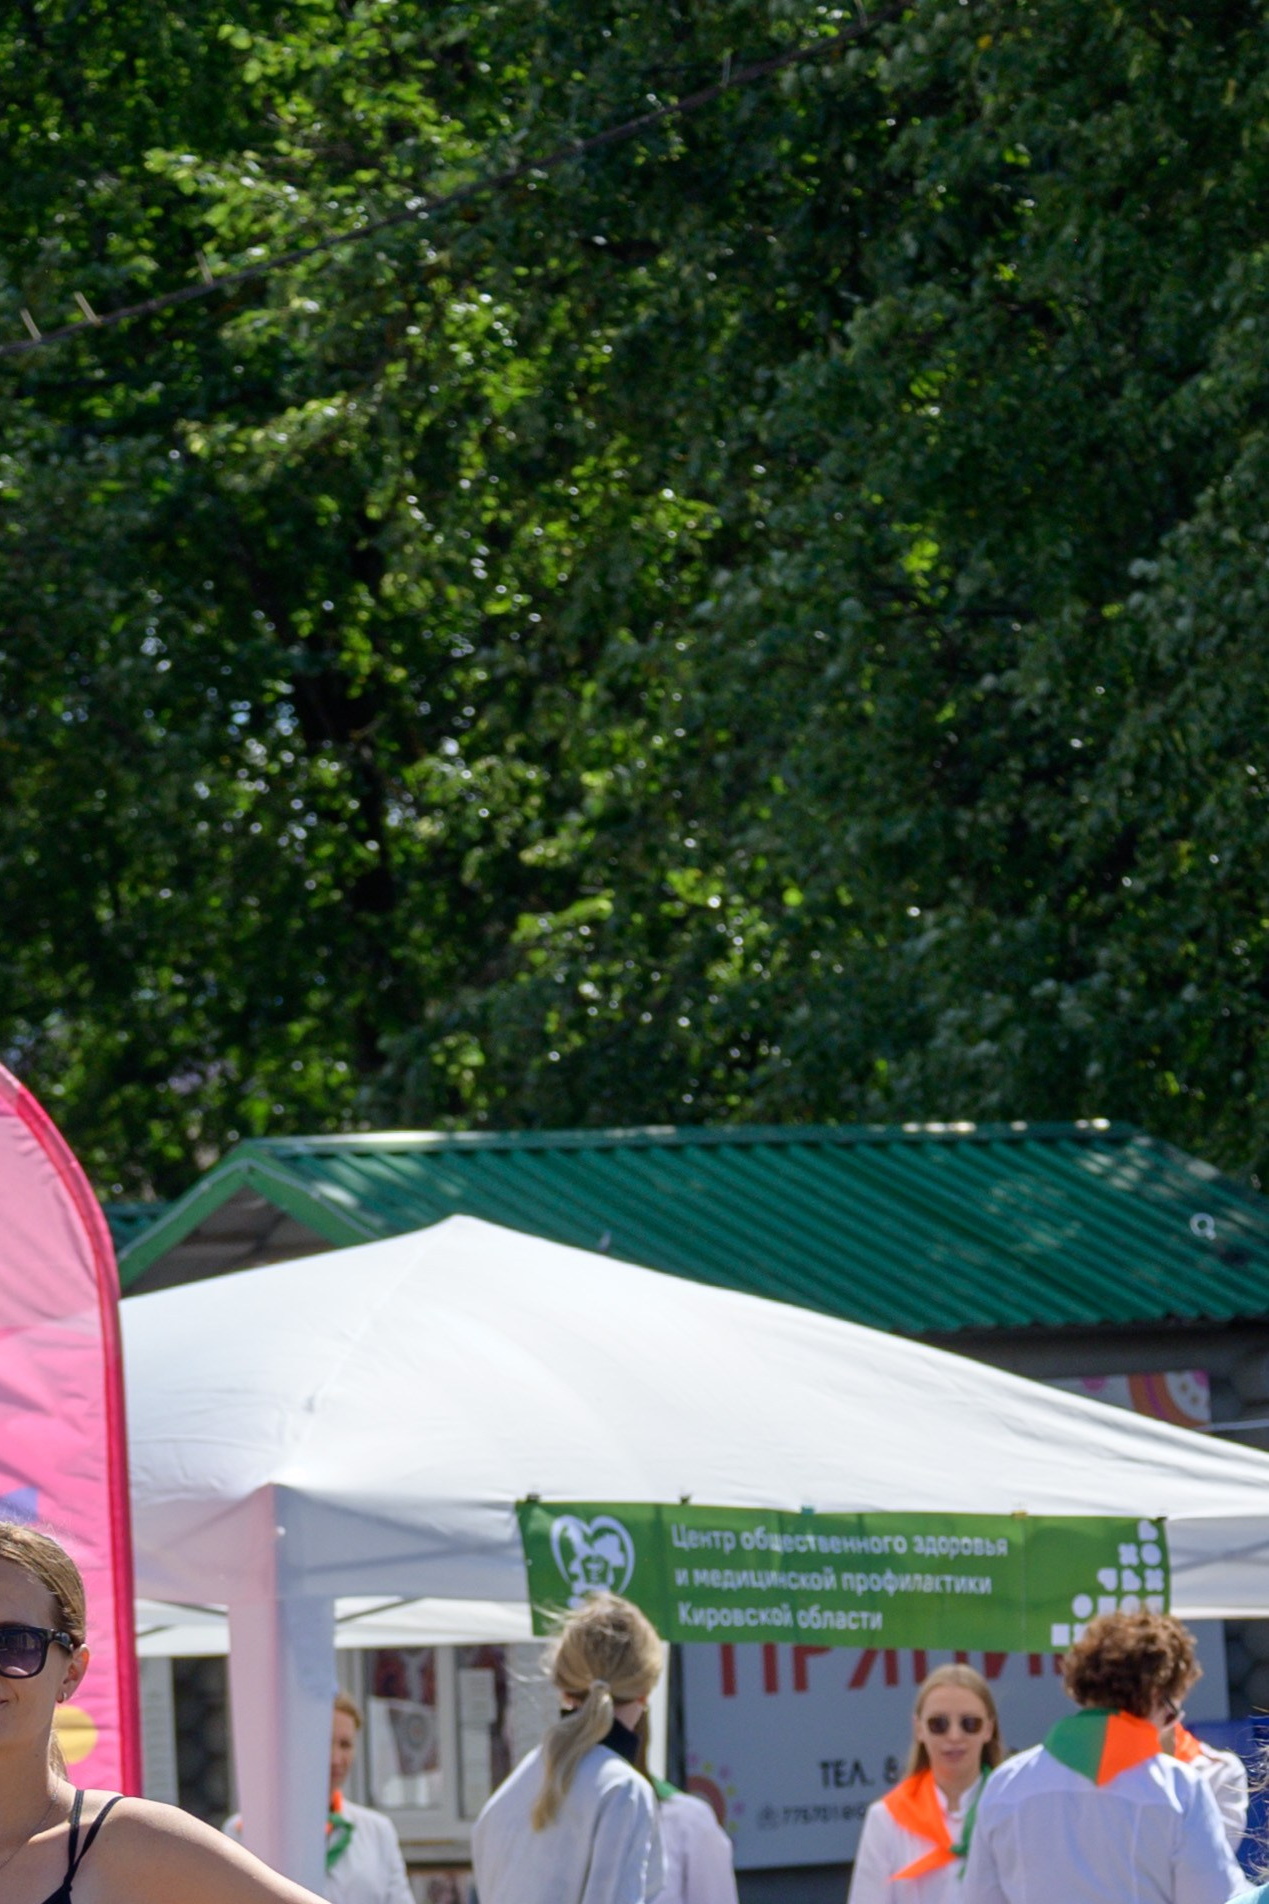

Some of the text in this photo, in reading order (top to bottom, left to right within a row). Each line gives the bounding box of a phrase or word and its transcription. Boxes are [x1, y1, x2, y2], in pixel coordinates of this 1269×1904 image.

[671, 1523, 1008, 1560] Центр общественного здоровья
[675, 1566, 992, 1597] и медицинской профилактики
[678, 1601, 883, 1631] Кировской области
